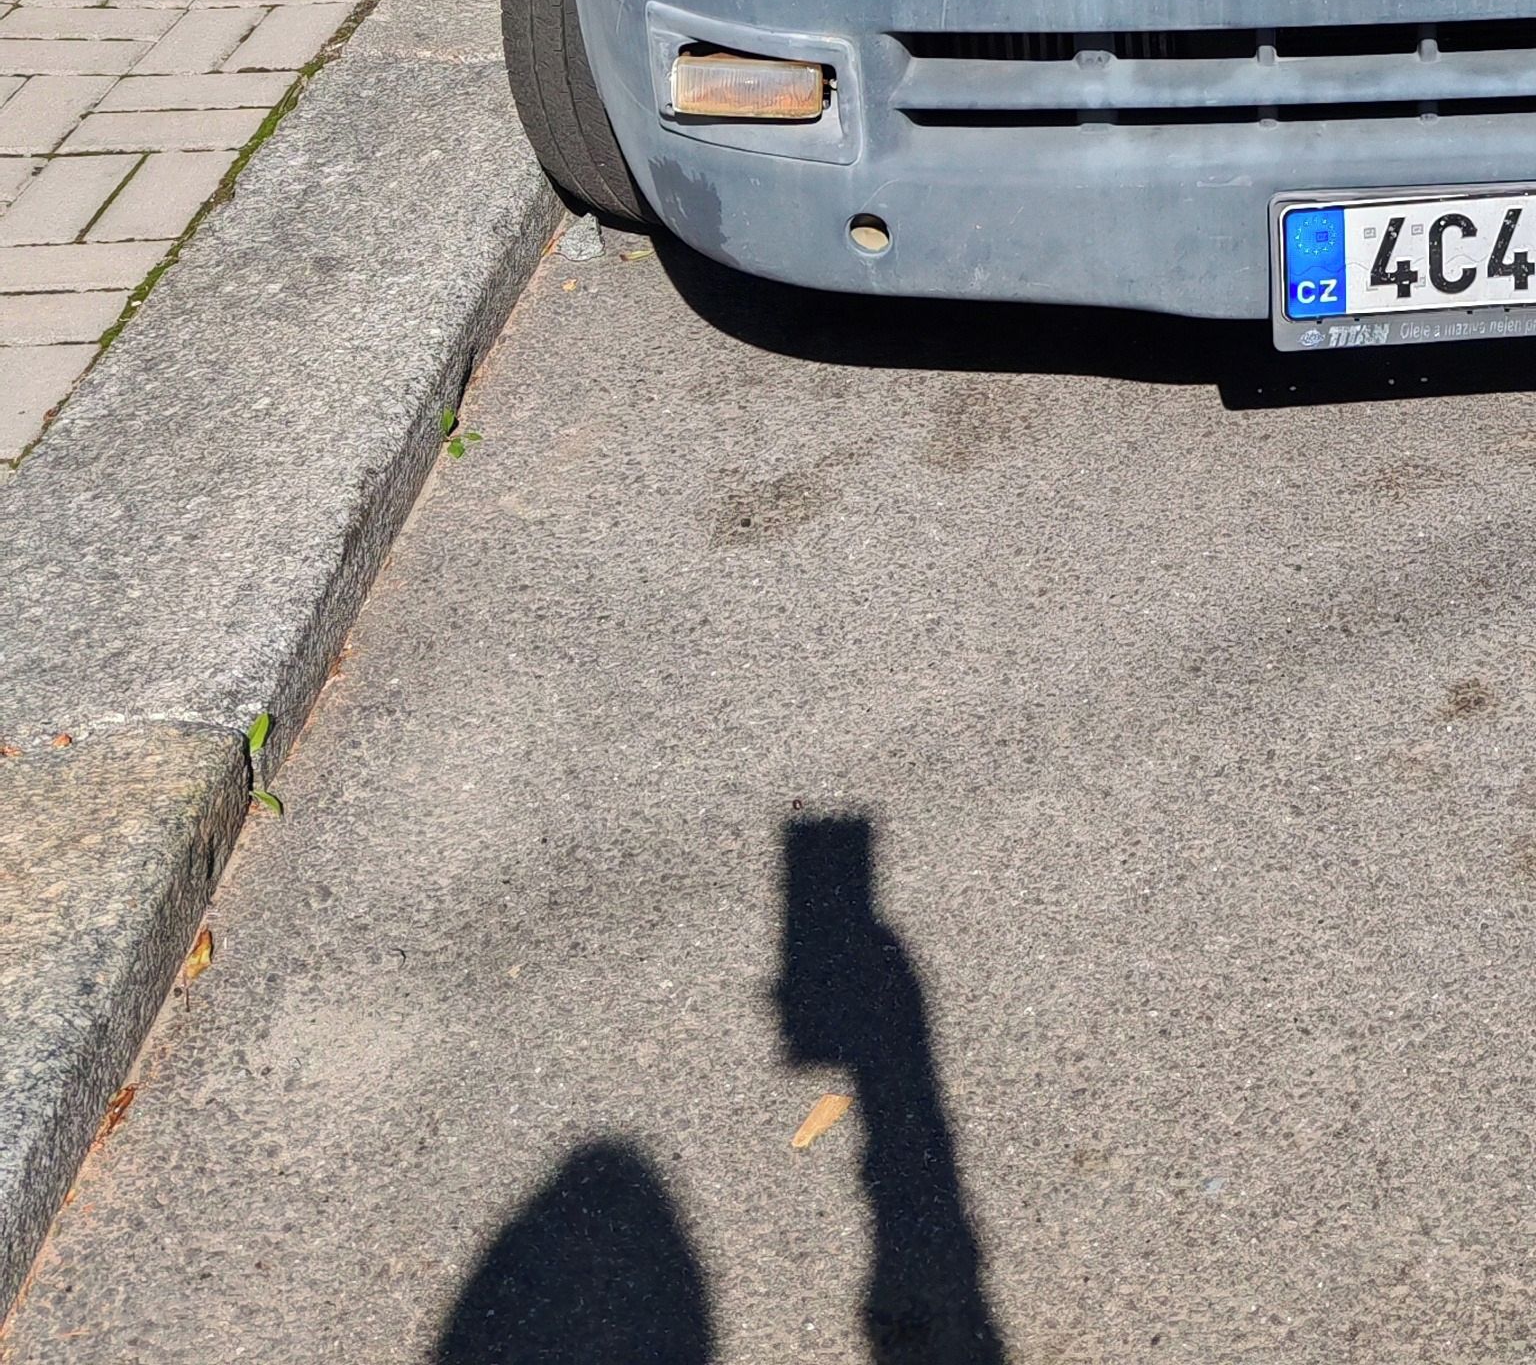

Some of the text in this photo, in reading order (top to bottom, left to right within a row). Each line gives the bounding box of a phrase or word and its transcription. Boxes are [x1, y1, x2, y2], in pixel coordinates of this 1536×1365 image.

[1370, 208, 1536, 298] 4C4
[1297, 279, 1338, 304] CZ
[1328, 323, 1391, 347] TITAN
[1400, 322, 1431, 341] Oleje
[1434, 324, 1441, 337] a
[1489, 316, 1522, 336] nejen
